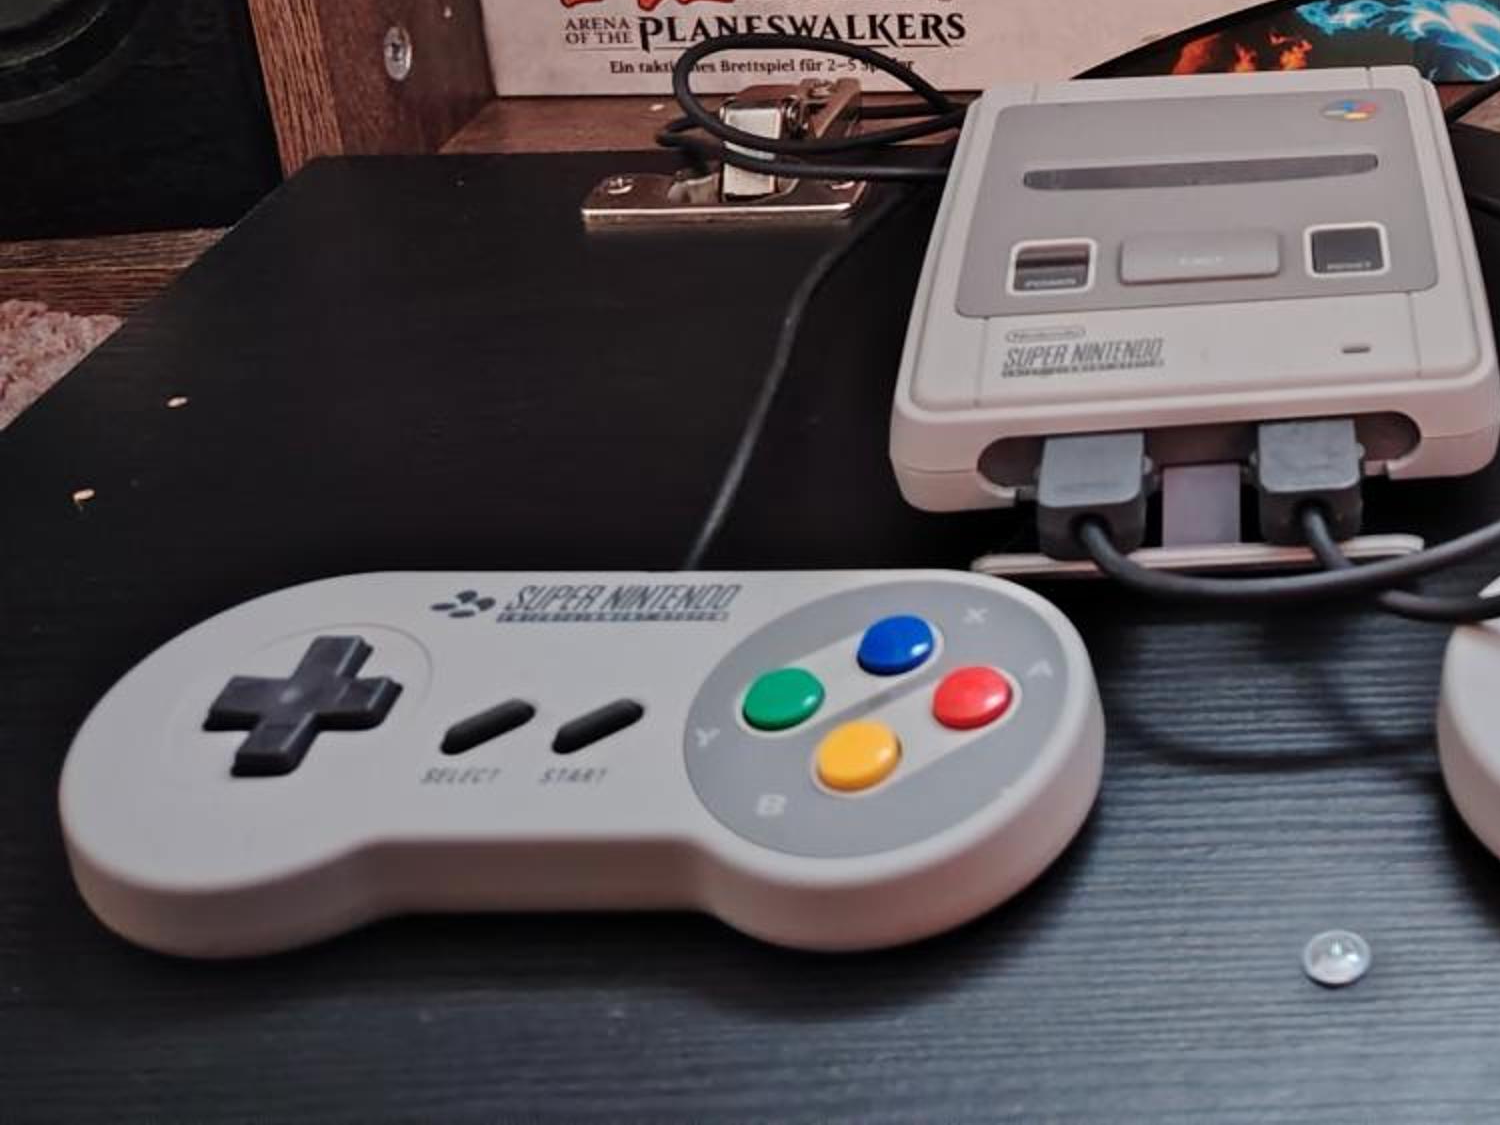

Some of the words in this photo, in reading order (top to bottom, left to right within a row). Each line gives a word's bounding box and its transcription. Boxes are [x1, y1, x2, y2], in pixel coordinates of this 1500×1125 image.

[565, 17, 631, 30] ARENA
[565, 31, 593, 44] OF
[597, 30, 633, 44] THE
[609, 60, 635, 74] Ein
[719, 58, 796, 77] Brettspiel
[800, 58, 822, 74] für
[1006, 344, 1068, 367] SUPER
[1070, 337, 1165, 364] NINTENDO
[503, 584, 608, 612] SUPER
[602, 584, 743, 612] NINTENDO
[420, 767, 502, 784] SELECT
[537, 767, 608, 784] START
